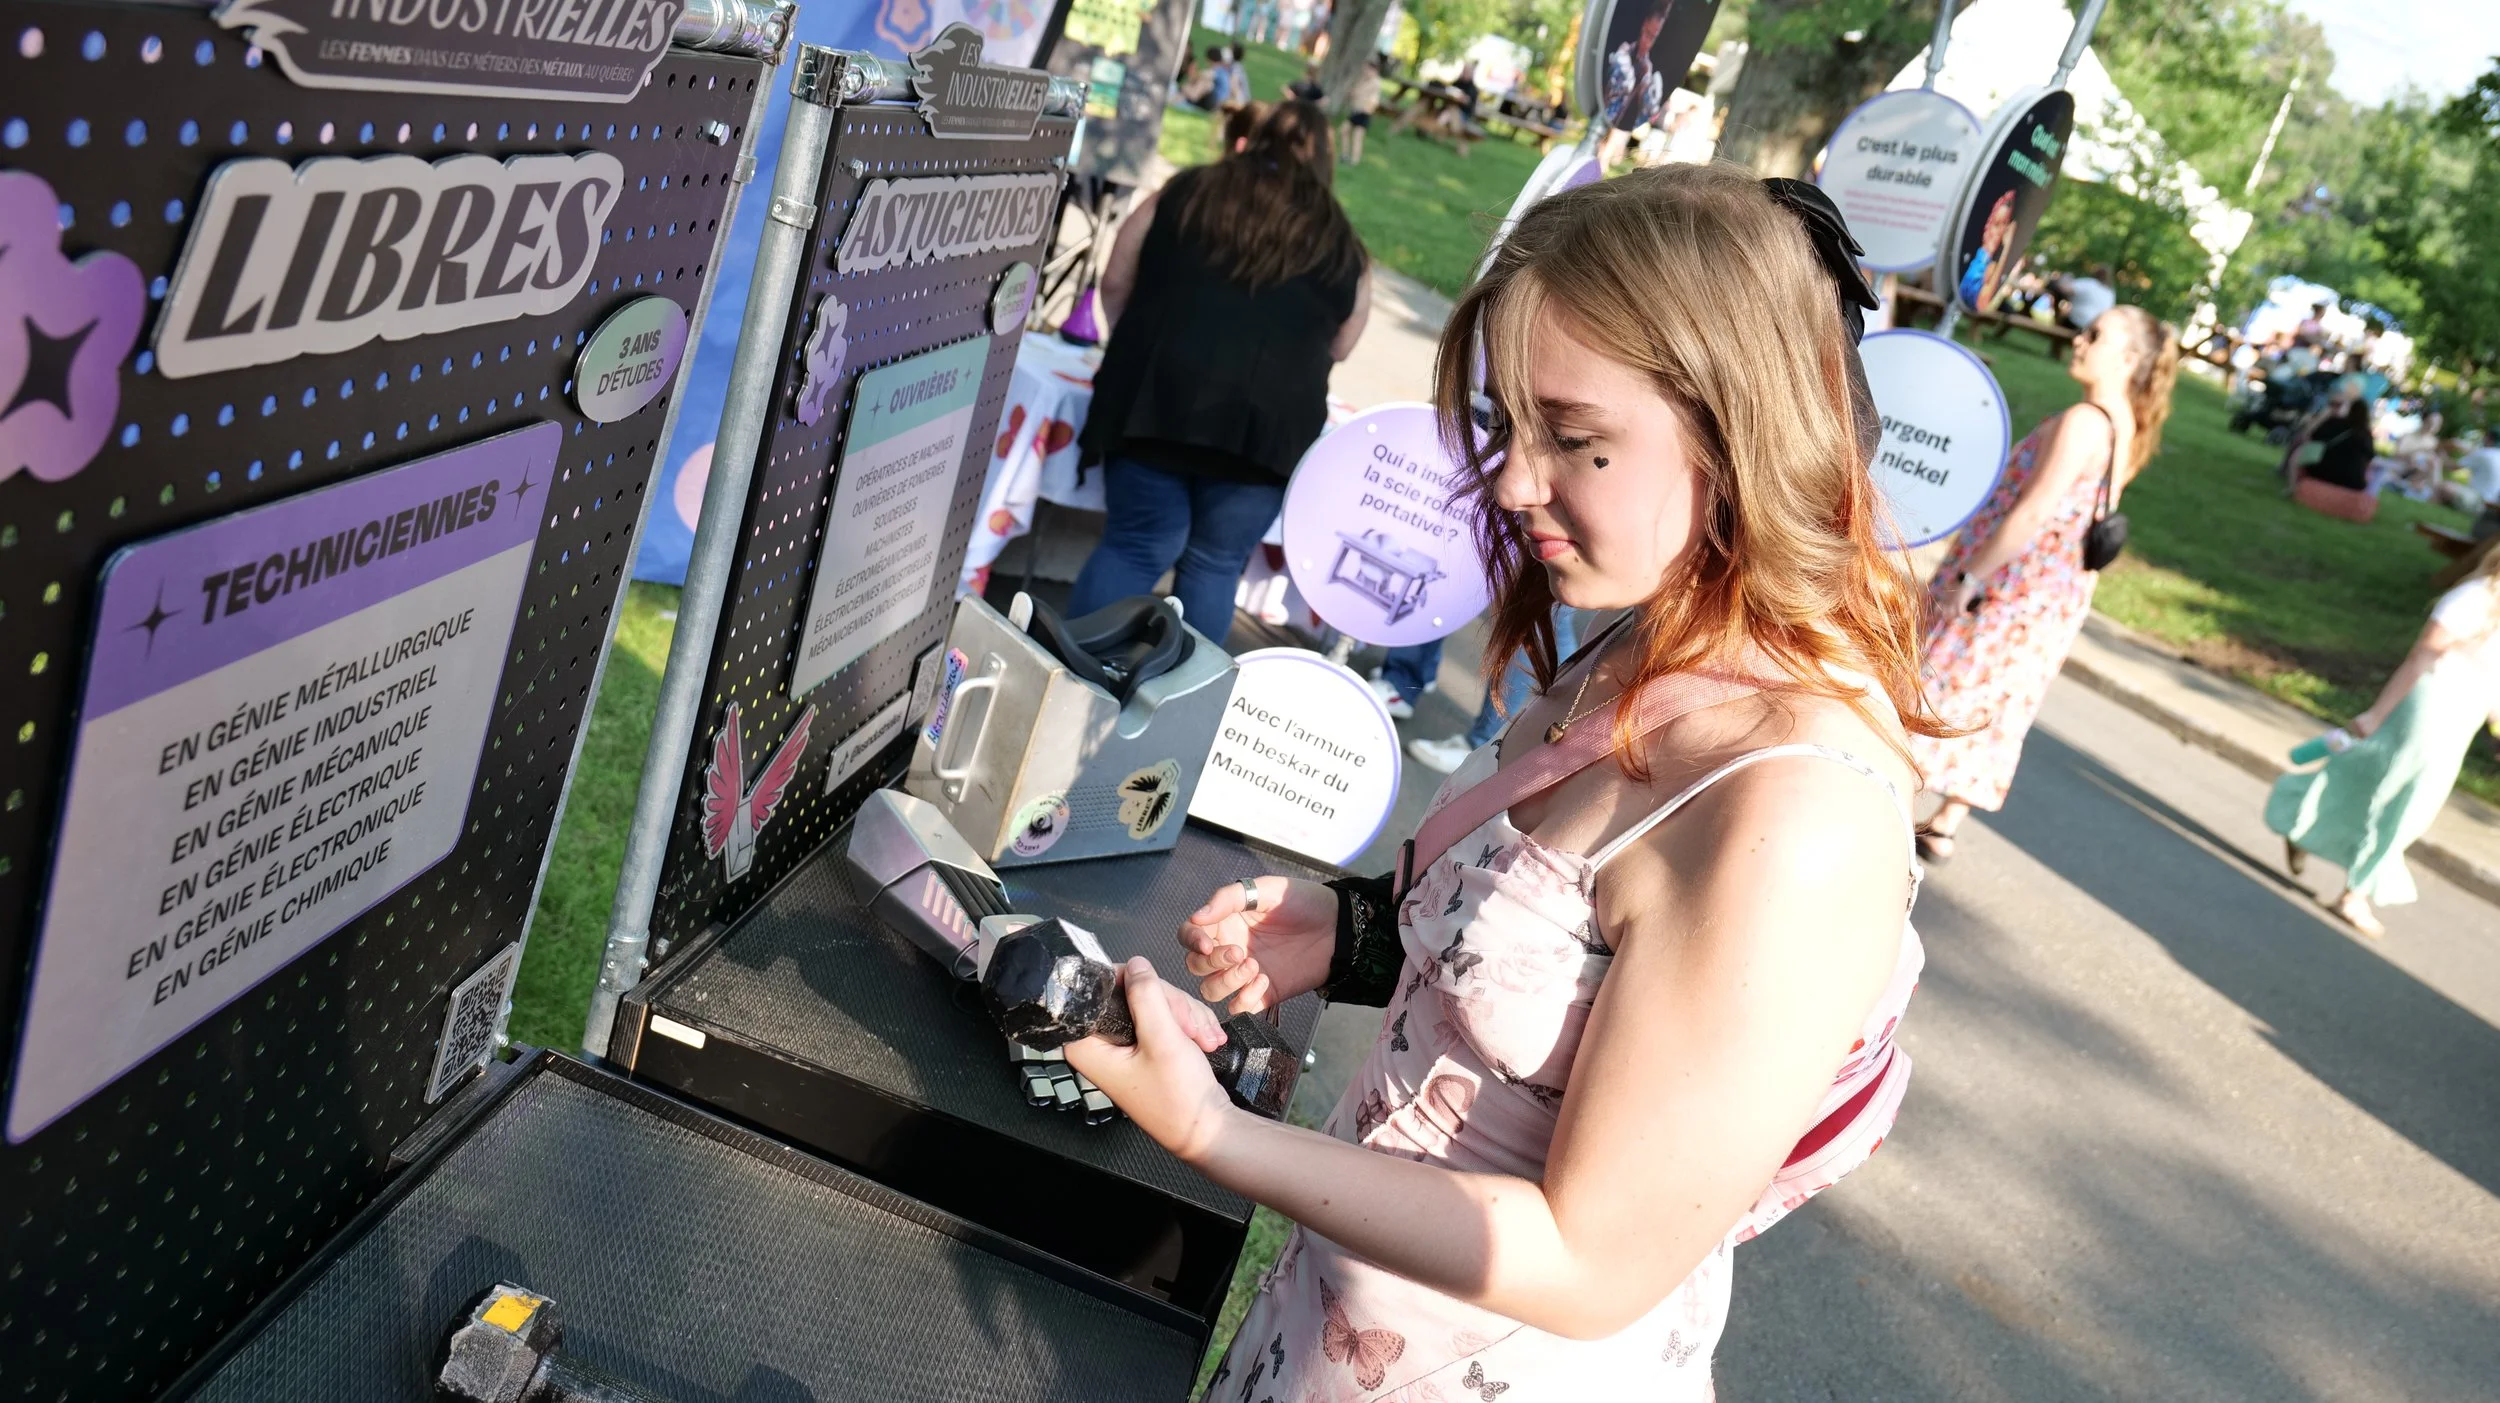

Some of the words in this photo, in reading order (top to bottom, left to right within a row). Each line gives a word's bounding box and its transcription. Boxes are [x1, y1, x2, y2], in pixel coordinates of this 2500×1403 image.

[319, 40, 347, 60] LES
[348, 41, 412, 64] FEMMES
[412, 48, 447, 67] DANS
[448, 51, 472, 69] LES
[471, 51, 519, 73] MÉTIERS
[519, 57, 542, 75] DES
[540, 57, 587, 79] MÉTAUX
[585, 64, 601, 80] AU
[600, 63, 635, 82] QUÉBEC
[959, 41, 981, 68] LES
[945, 71, 1047, 112] INDUSTRIELLES
[1857, 136, 1898, 156] C'est
[1901, 140, 1917, 158] le
[1919, 144, 1958, 163] plus
[1866, 164, 1932, 188] durable
[844, 184, 1053, 261] ASTUCIEUSES
[184, 176, 614, 342] LIBRES
[619, 336, 631, 359] 3
[629, 329, 661, 357] ANS
[596, 358, 664, 396] D'ÉTUDES
[889, 367, 959, 415] OUVRIÈRES
[856, 456, 908, 492] OPÉRATRICES
[908, 451, 919, 468] DE
[919, 434, 954, 460] MACHINES
[1363, 464, 1380, 484] la
[1383, 476, 1421, 502] scie
[1373, 443, 1407, 469] Qui
[1406, 462, 1418, 475] a
[1881, 451, 1949, 486] nickel
[852, 484, 897, 518] OUVRIÈRES
[897, 478, 909, 496] DE
[908, 460, 947, 490] FONDERIES
[873, 496, 918, 531] SOUDEUSES
[1360, 491, 1443, 537] portative
[1448, 528, 1458, 542] ?
[201, 478, 500, 626] TECHNICIENNES
[864, 520, 915, 558] MACHINISTES
[808, 608, 875, 661] MÉCANICIENNES
[874, 574, 927, 618] INDUSTRIELLES
[814, 583, 881, 634] ÉLECTRICIENNES
[881, 551, 933, 592] INDUSTRIELLES
[158, 736, 201, 776] EN
[206, 690, 291, 752] GÉNIE
[294, 608, 475, 712] MÉTALLURGIQUE
[183, 771, 223, 812] EN
[229, 726, 309, 790] GÉNIE
[312, 664, 439, 747] INDUSTRIEL
[1224, 727, 1248, 747] en
[1252, 737, 1320, 780] beskar
[1323, 772, 1350, 793] du
[1232, 696, 1281, 728] Avec
[1284, 719, 1366, 768] l'armure
[170, 825, 209, 865] EN
[217, 776, 298, 842] GÉNIE
[300, 705, 433, 795] MÉCANIQUE
[1211, 751, 1336, 820] Mandalorien
[158, 876, 199, 917] EN
[204, 826, 283, 892] GÉNIE
[288, 747, 424, 843] ÉLECTRIQUE
[126, 939, 168, 980] EN
[173, 892, 256, 954] GÉNIE
[260, 782, 427, 898] ÉLECTRONIQUE
[153, 963, 192, 1006] EN
[198, 918, 275, 981] GÉNIE
[280, 838, 392, 925] CHIMIQUE
